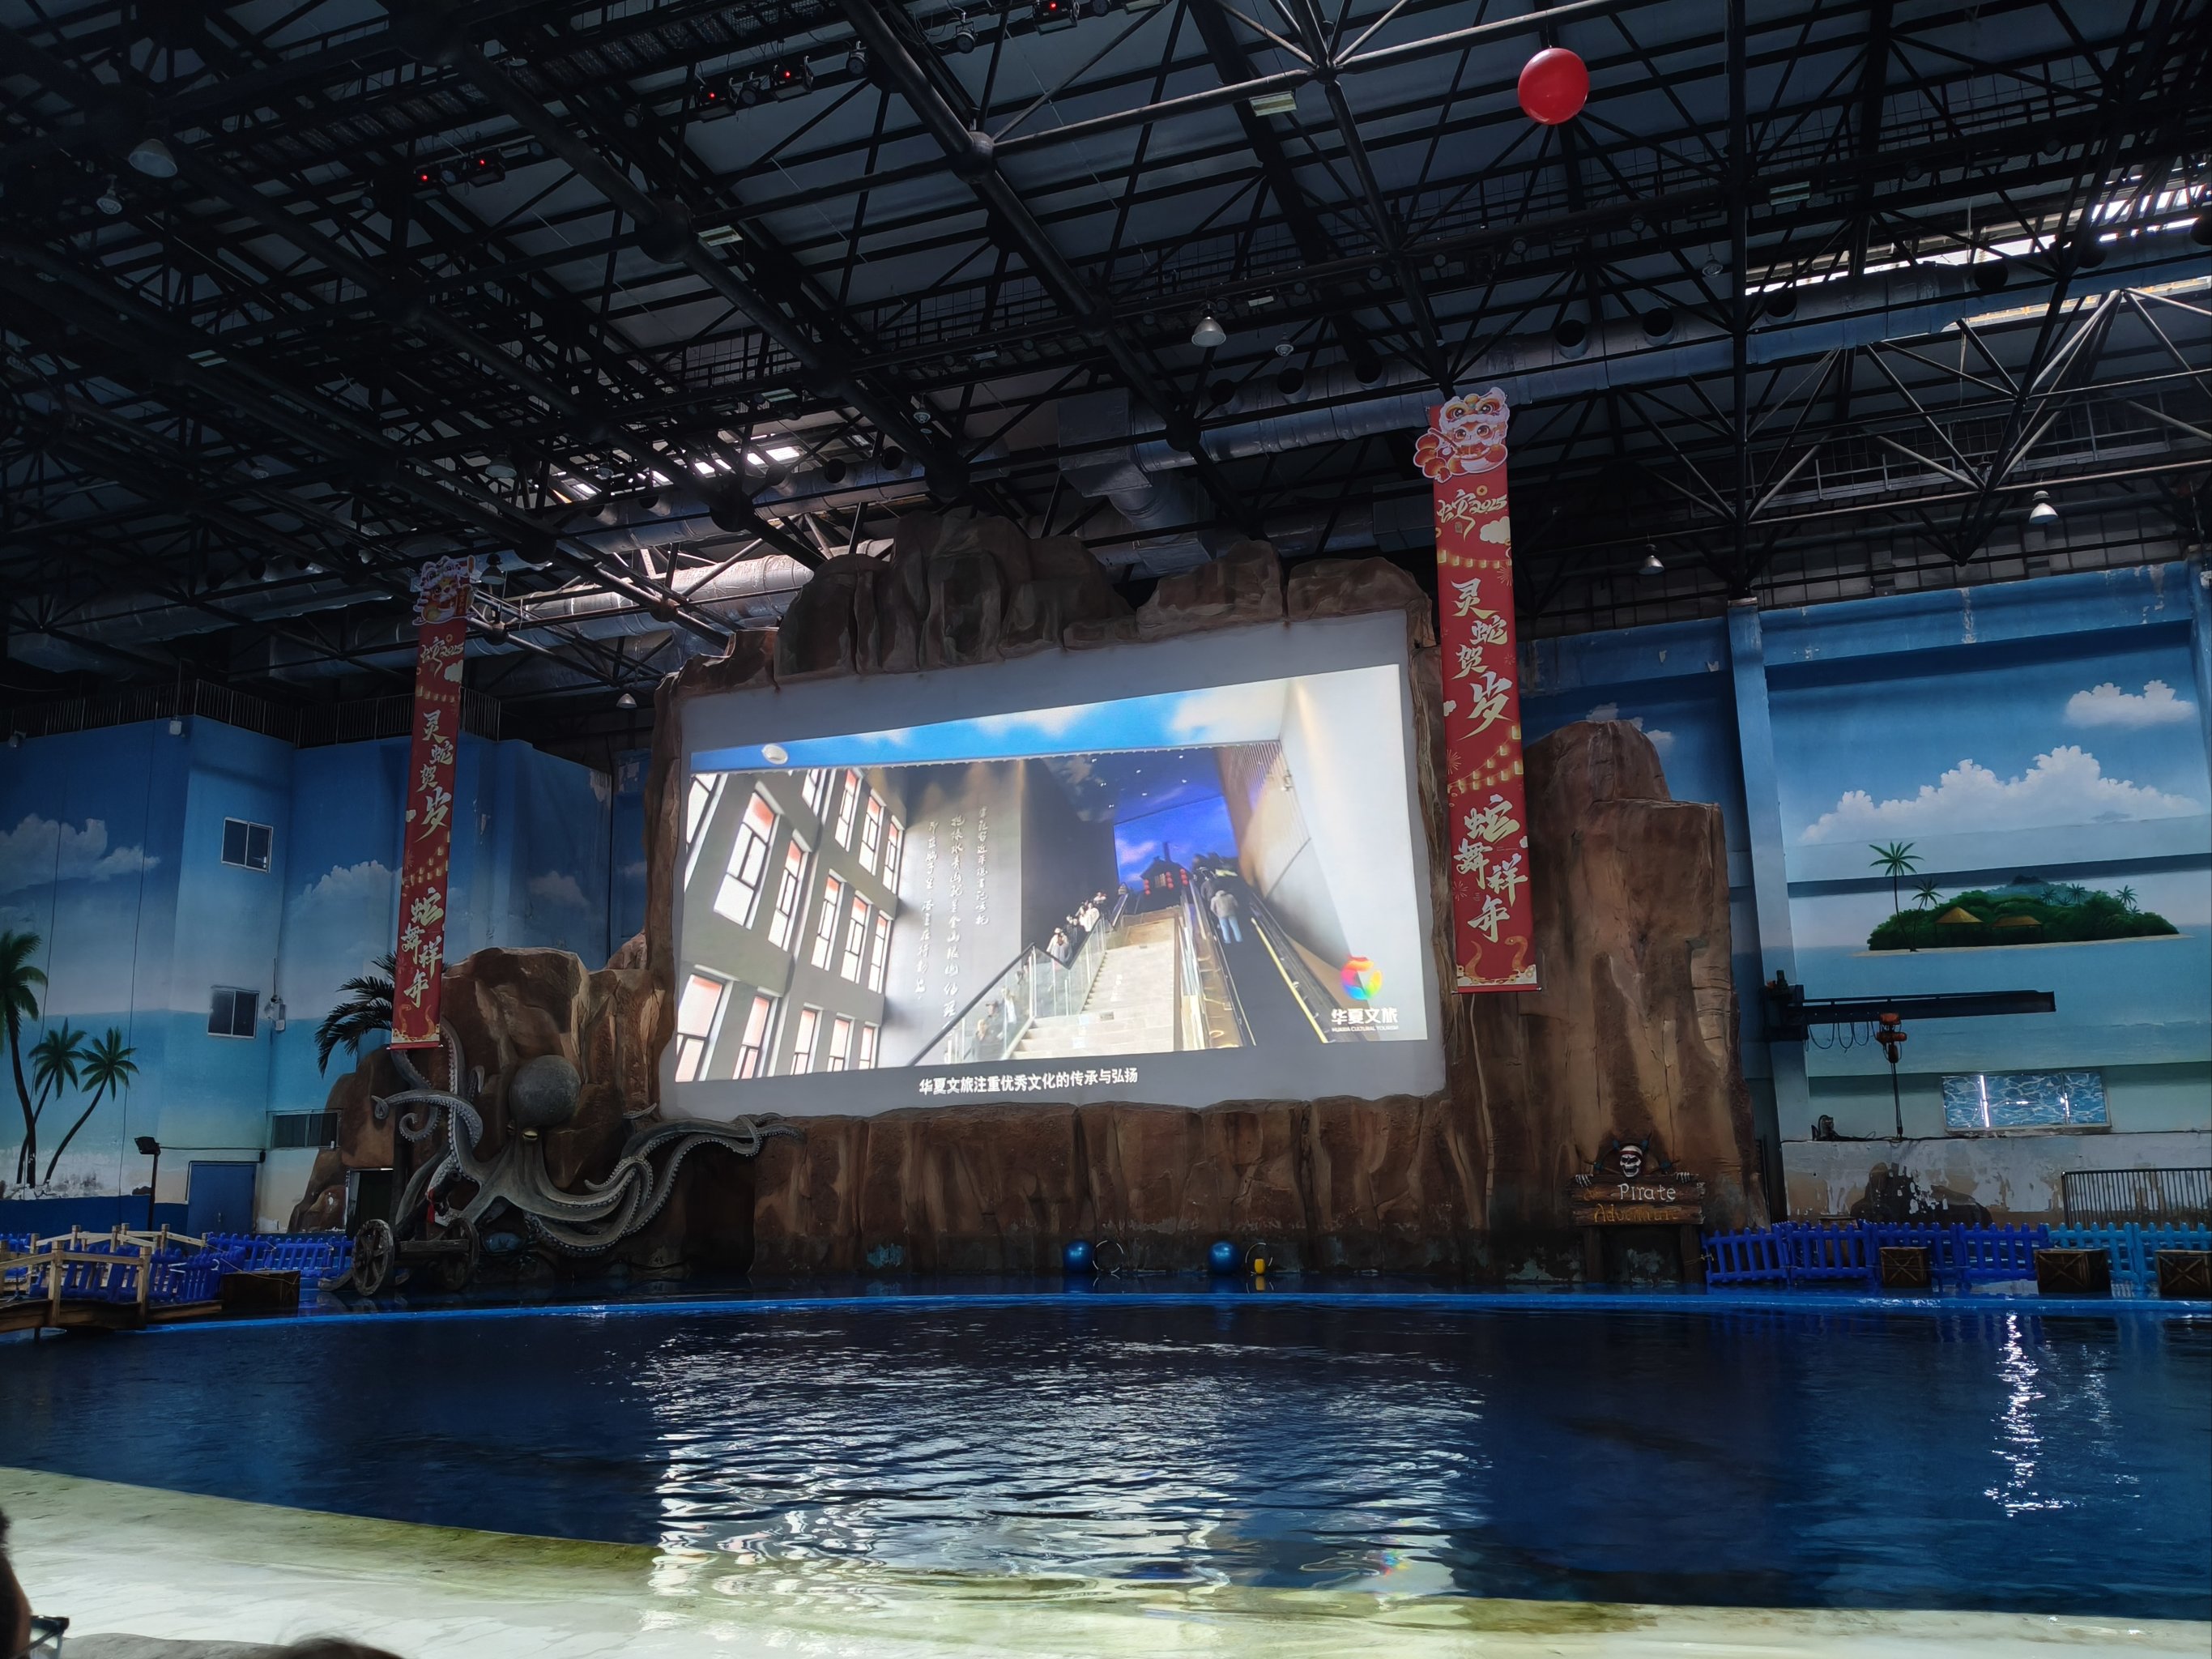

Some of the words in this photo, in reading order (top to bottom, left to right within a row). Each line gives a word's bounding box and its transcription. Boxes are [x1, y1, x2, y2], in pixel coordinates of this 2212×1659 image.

[1451, 577, 1514, 742] 灵蛇贺岁
[413, 709, 454, 843] 灵蛇贺岁
[1453, 793, 1528, 944] 蛇舞祥年
[400, 886, 445, 1008] 蛇舞祥年
[1331, 1007, 1399, 1025] 华夏文旅
[918, 1067, 1138, 1095] 华夏文旅注重优秀文化的传承与弘扬
[1617, 1183, 1677, 1203] Pirate
